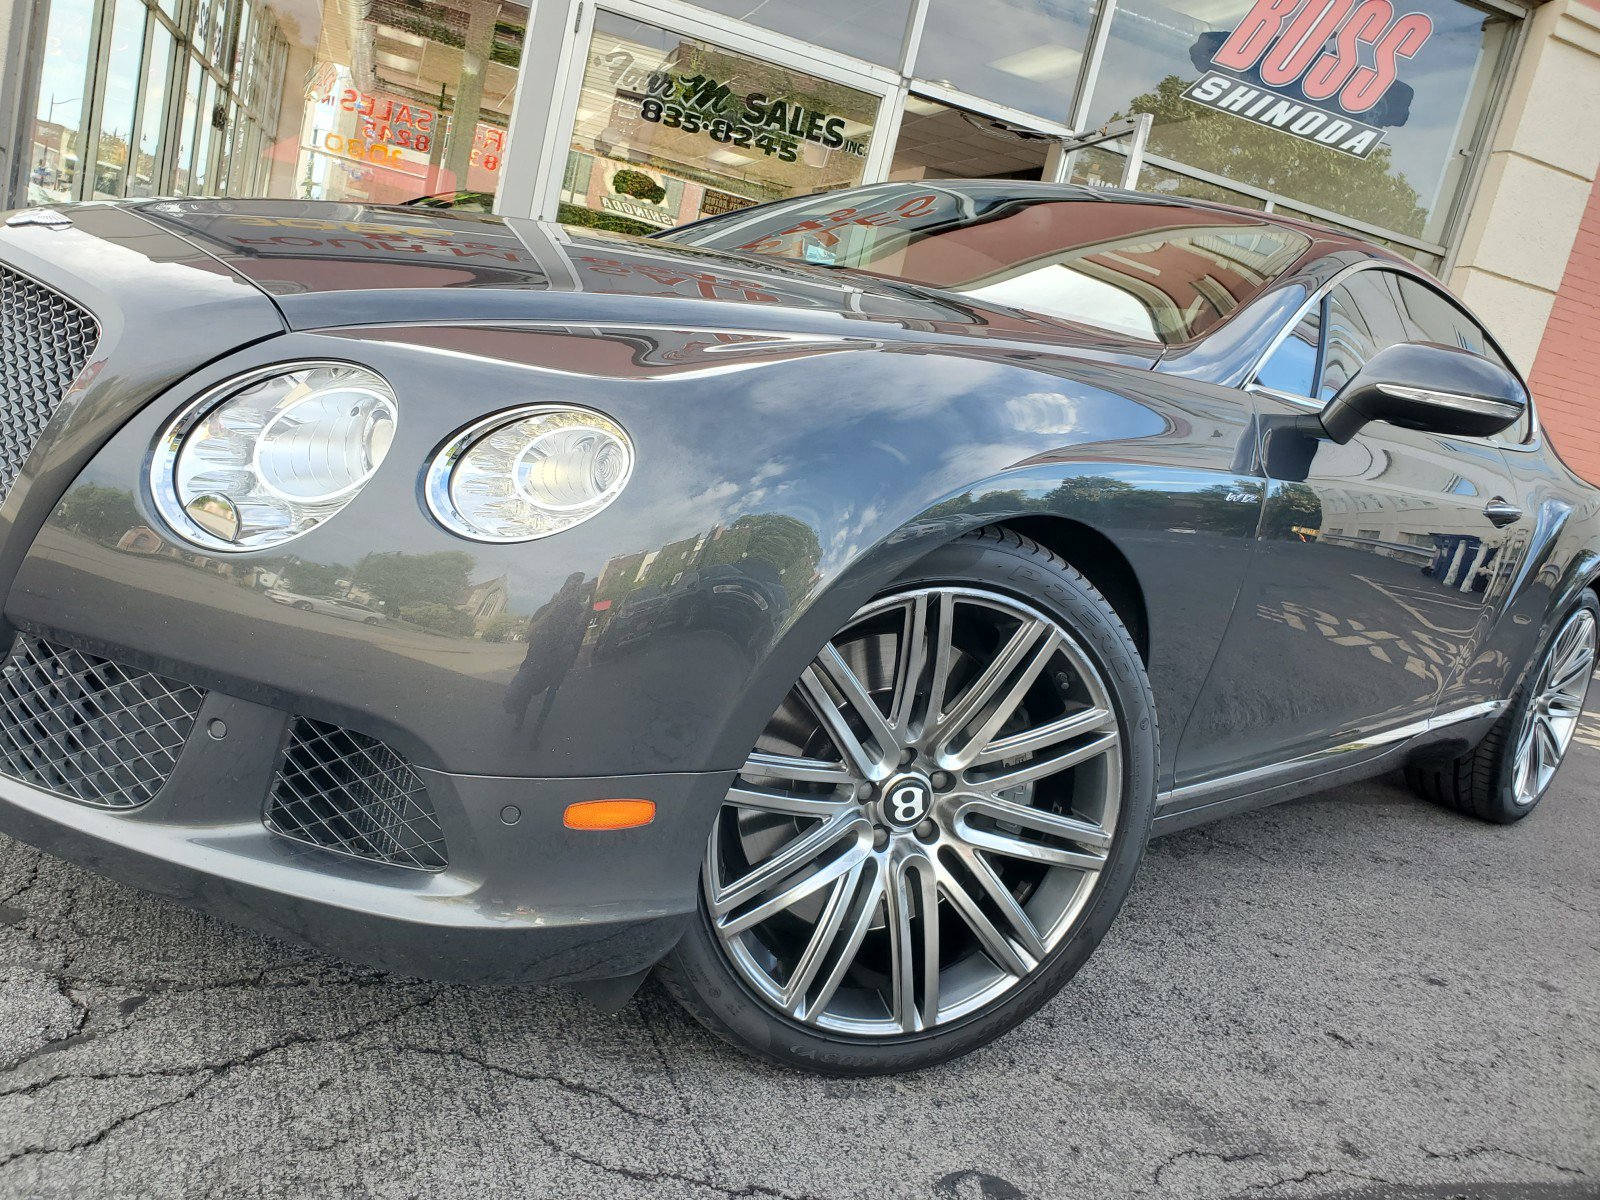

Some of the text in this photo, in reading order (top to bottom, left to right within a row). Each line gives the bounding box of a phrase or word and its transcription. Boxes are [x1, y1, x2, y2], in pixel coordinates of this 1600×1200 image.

[1210, 0, 1433, 113] BOSS
[742, 92, 846, 151] SALES
[845, 139, 867, 159] INC.
[1191, 76, 1378, 155] SHINODA
[892, 786, 924, 822] B
